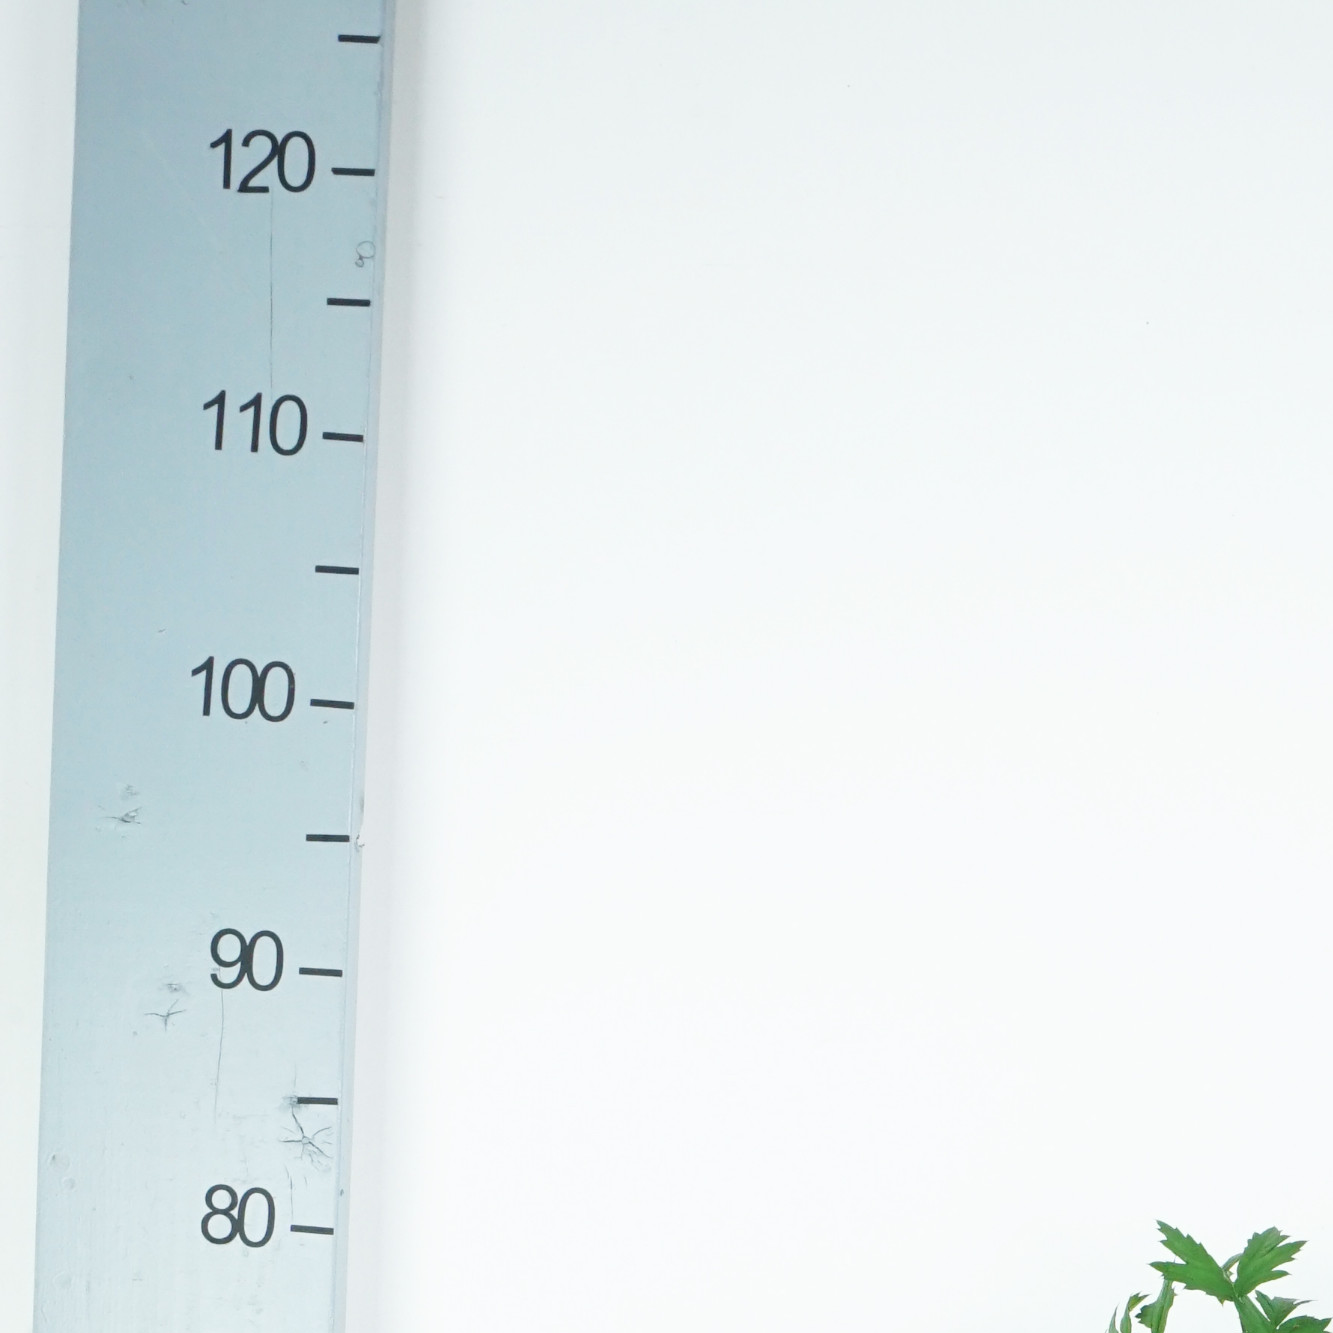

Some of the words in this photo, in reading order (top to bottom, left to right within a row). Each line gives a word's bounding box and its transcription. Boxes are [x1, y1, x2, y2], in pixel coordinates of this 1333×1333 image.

[208, 129, 316, 193] 120
[202, 393, 308, 455] 110
[191, 658, 296, 723] 100
[209, 929, 284, 992] 90
[200, 1186, 275, 1249] 80
